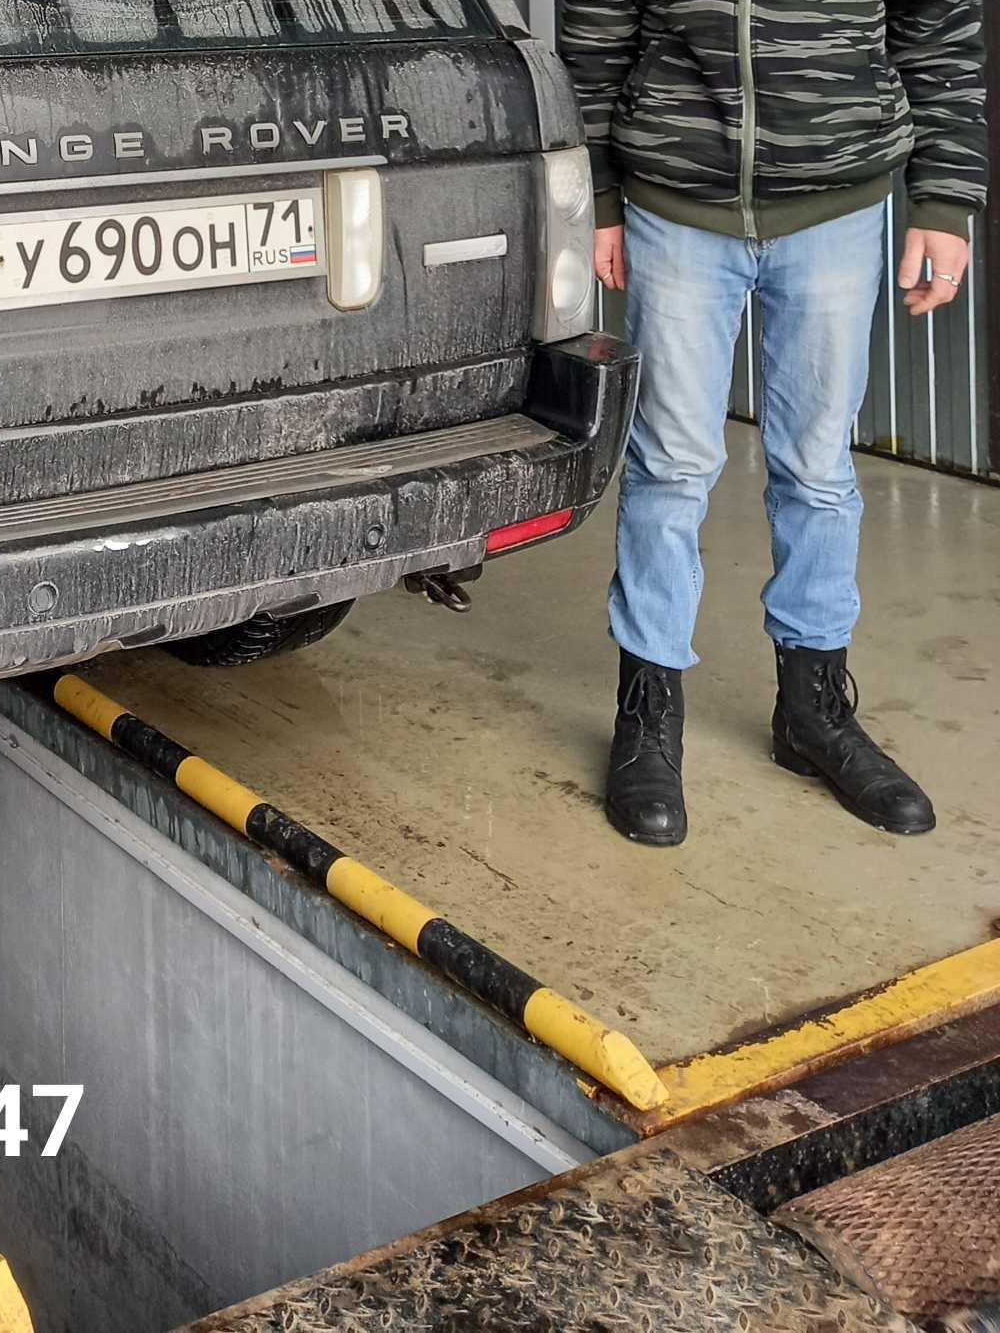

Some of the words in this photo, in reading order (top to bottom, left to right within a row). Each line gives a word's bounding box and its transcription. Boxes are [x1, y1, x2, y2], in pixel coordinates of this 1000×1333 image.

[201, 113, 410, 152] ROVER
[253, 199, 301, 247] 71
[252, 249, 289, 265] RUS
